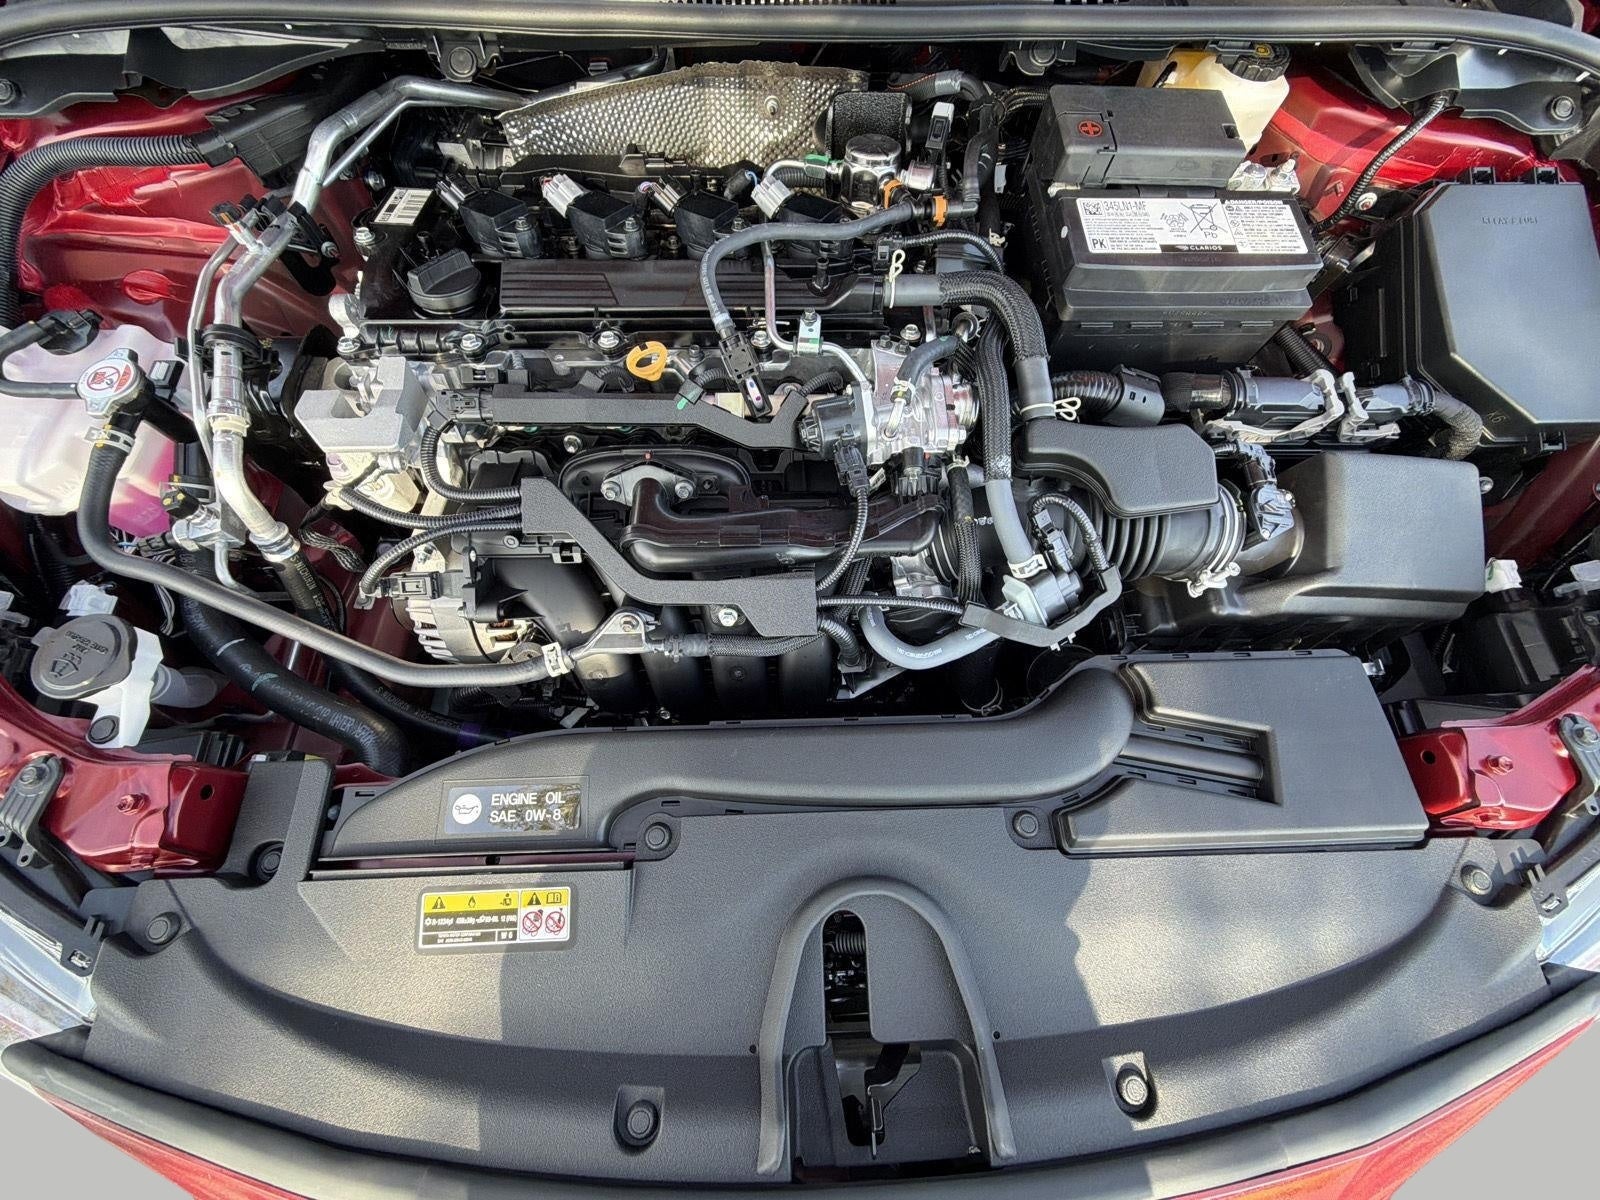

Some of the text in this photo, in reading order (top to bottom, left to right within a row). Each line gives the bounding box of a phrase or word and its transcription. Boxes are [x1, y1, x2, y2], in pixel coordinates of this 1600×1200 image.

[1203, 231, 1218, 240] Pb
[1091, 238, 1107, 249] PK
[490, 791, 566, 806] ENGINE OIL
[489, 808, 562, 823] SAE 0W-8
